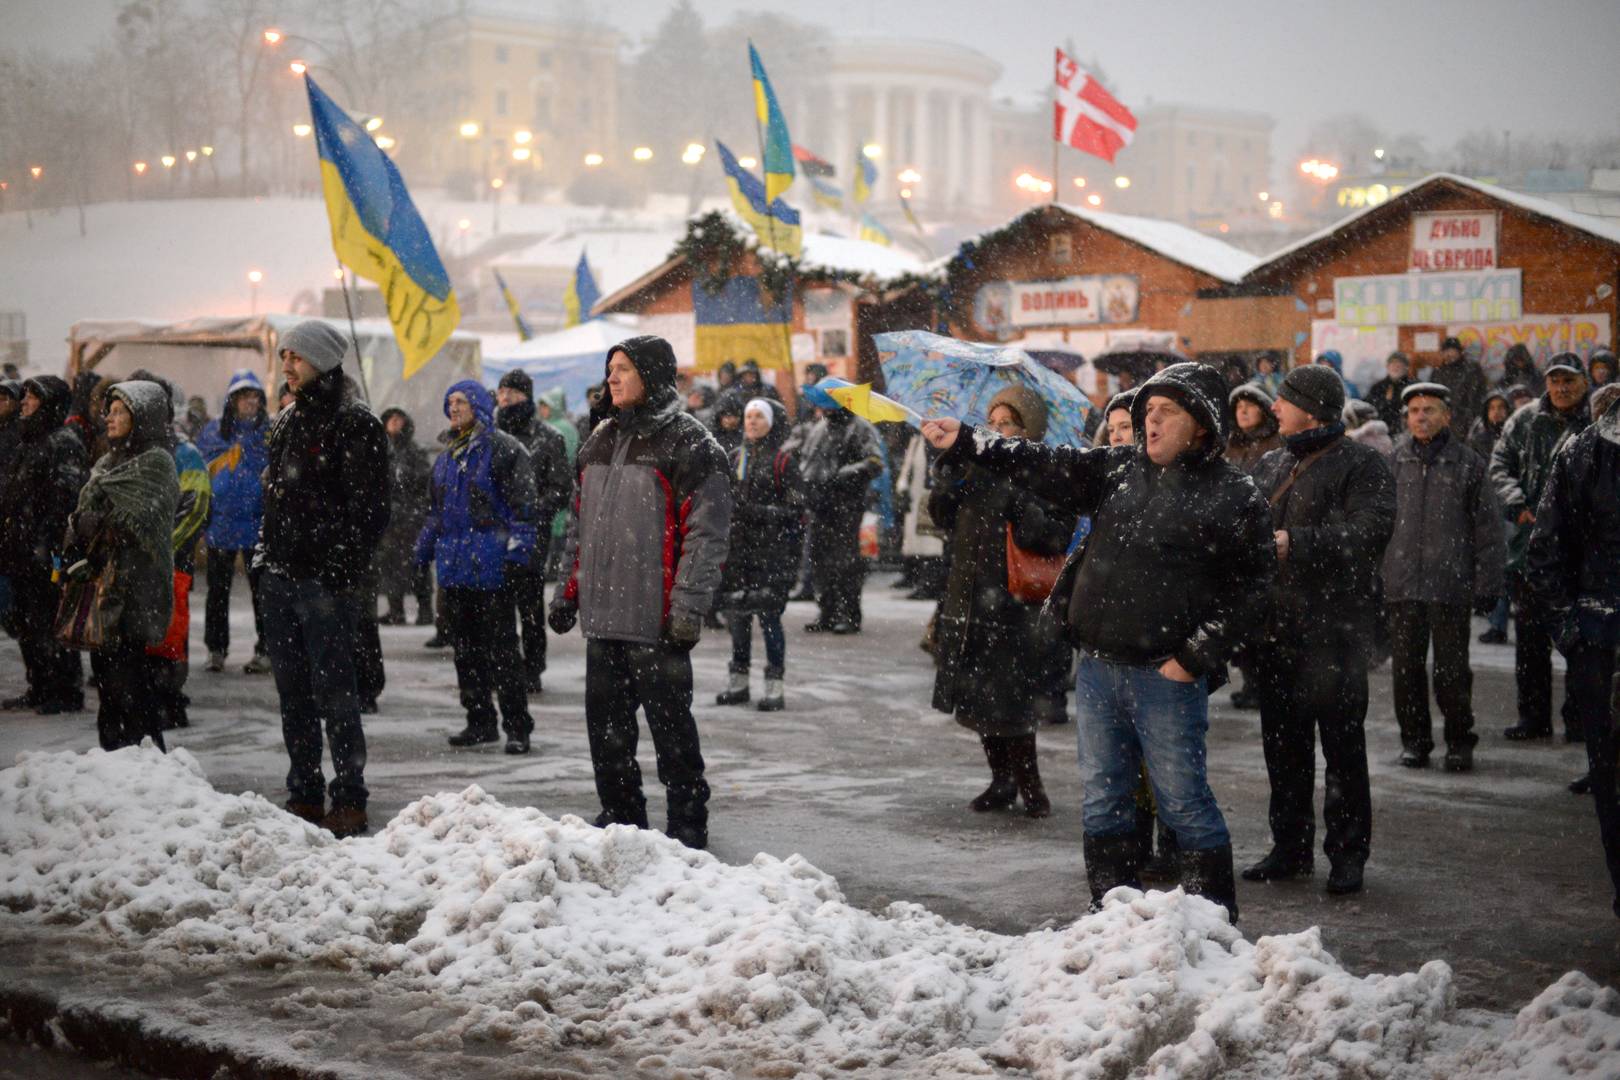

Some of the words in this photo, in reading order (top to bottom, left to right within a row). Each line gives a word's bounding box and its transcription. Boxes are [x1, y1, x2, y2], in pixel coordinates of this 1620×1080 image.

[1430, 218, 1480, 240] ДУБНО
[1436, 249, 1494, 268] ЄВРОПА
[1022, 290, 1088, 312] ВОЛИНЬ
